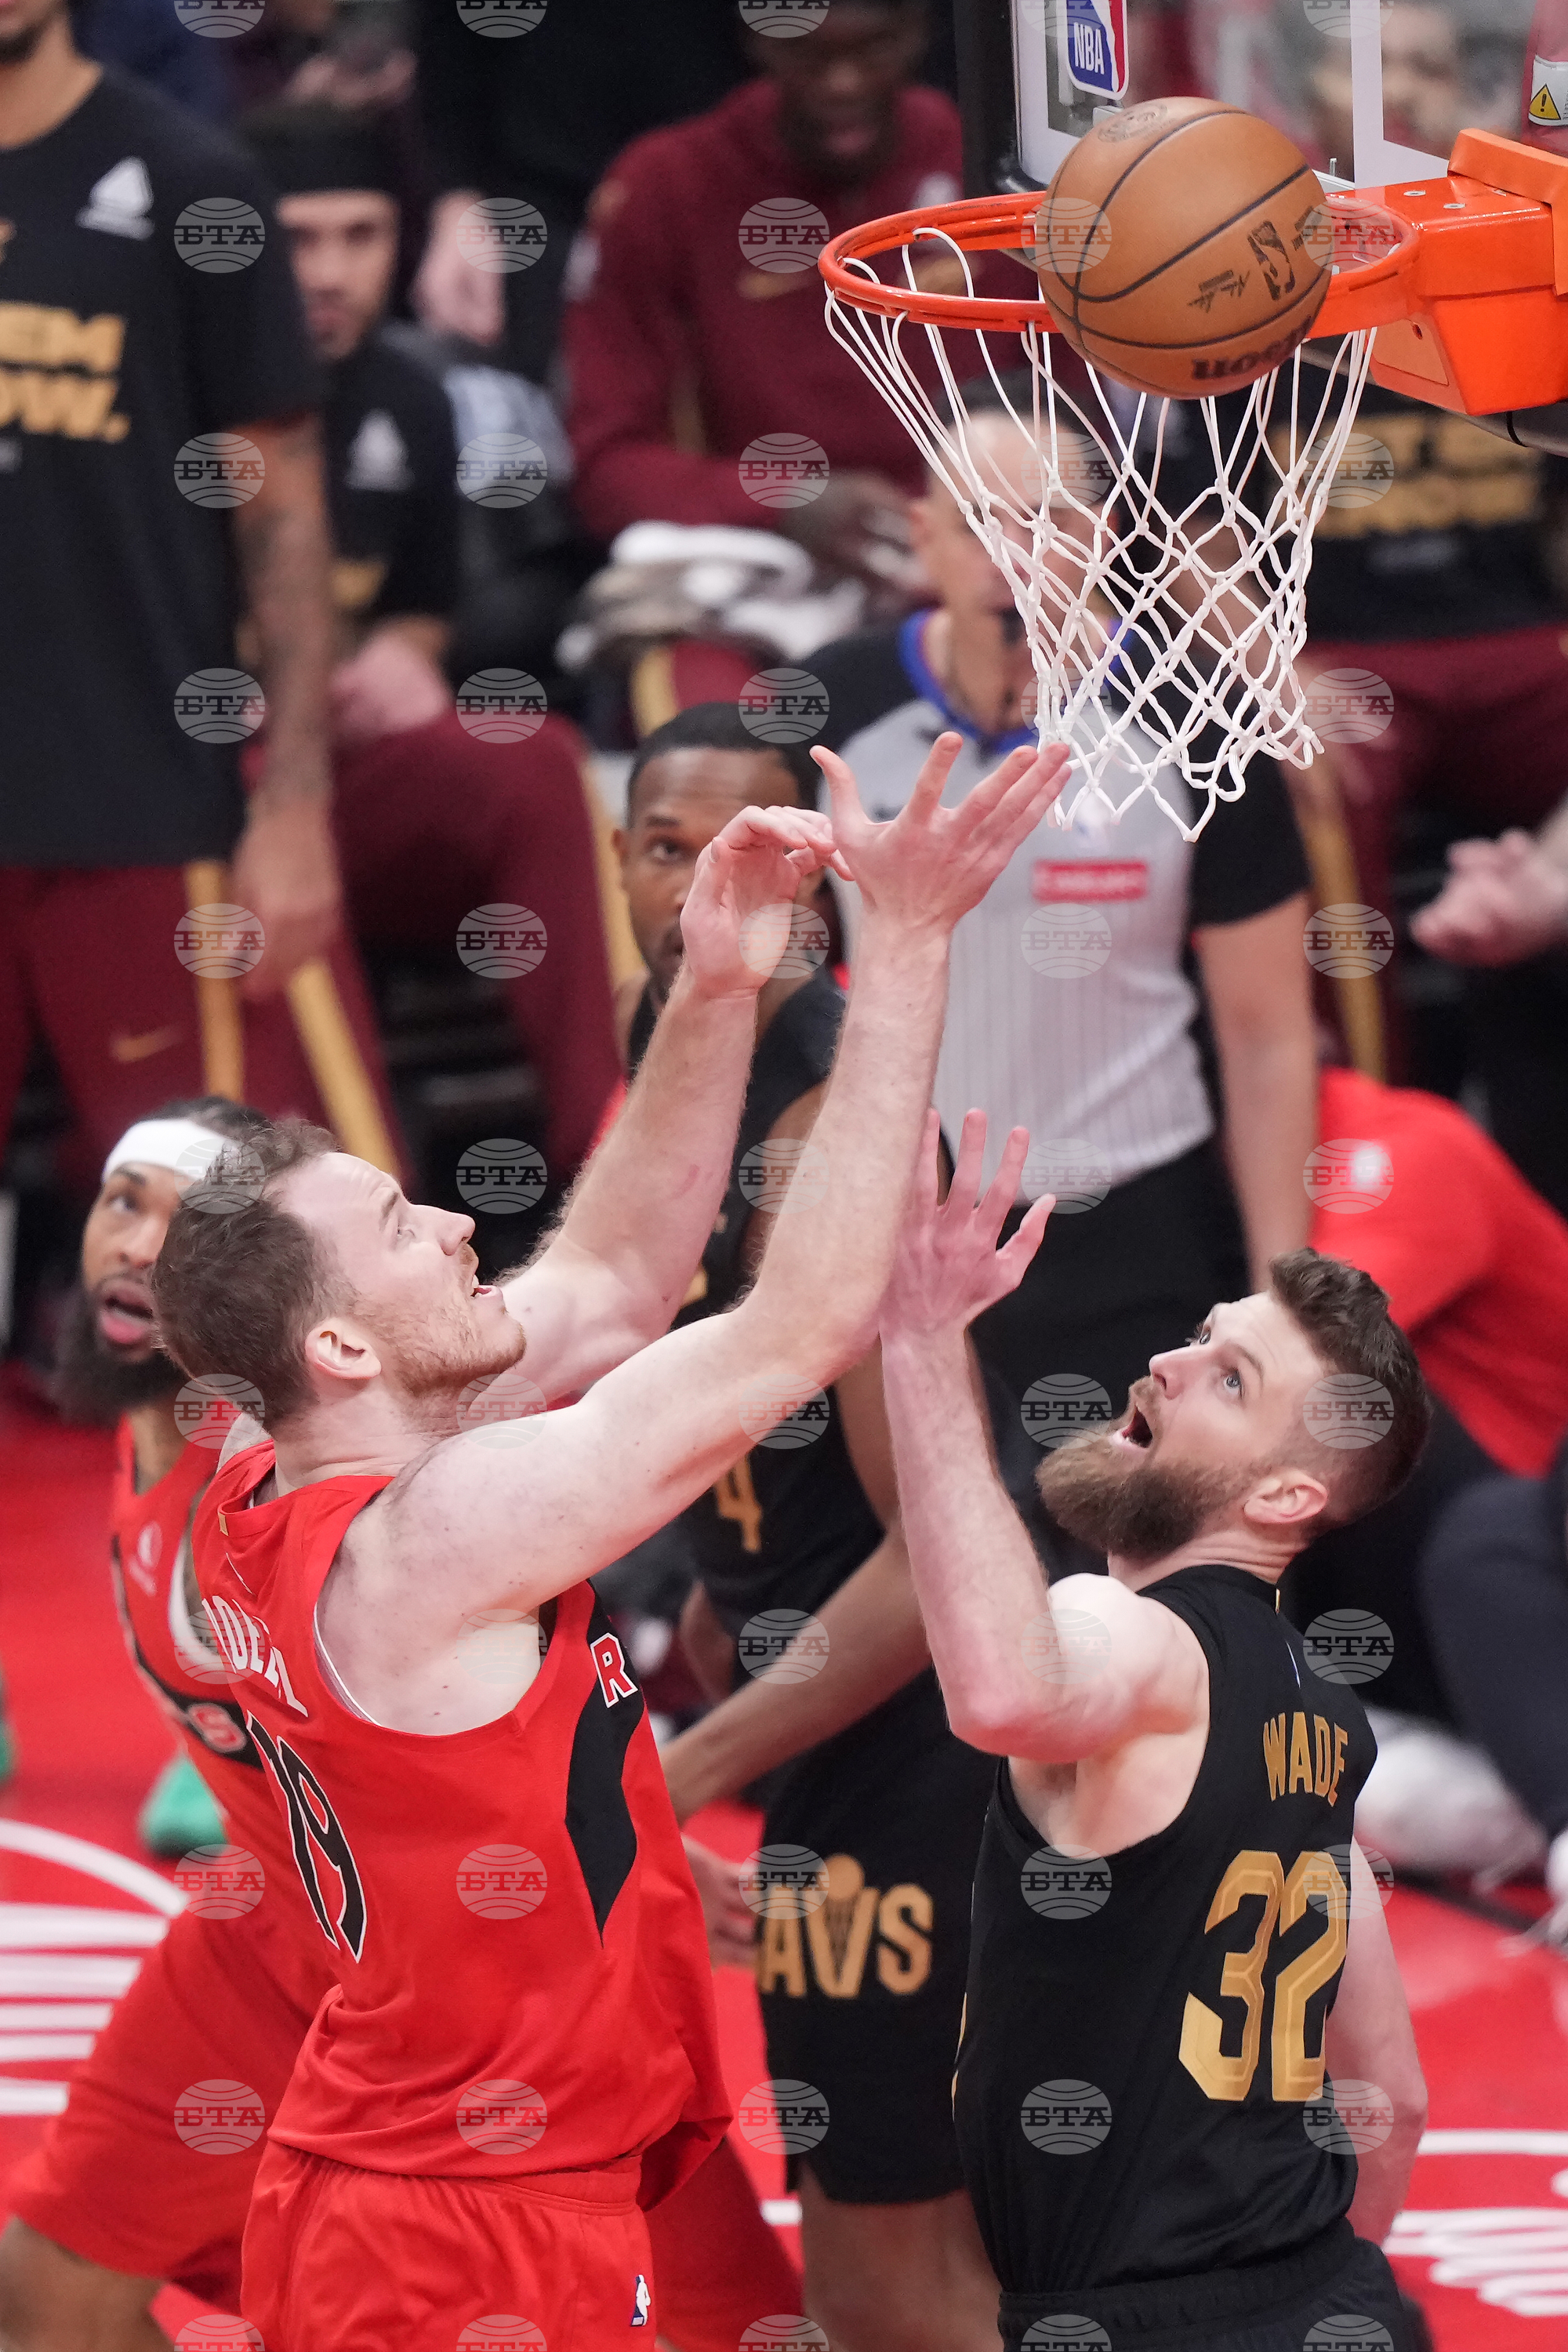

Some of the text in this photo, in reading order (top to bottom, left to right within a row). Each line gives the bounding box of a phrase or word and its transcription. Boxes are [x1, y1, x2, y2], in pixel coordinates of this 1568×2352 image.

[1073, 22, 1105, 74] NBA
[590, 1632, 639, 1708] R
[1263, 1711, 1348, 1807] WADE
[246, 1709, 367, 1963] 19
[1178, 1849, 1348, 2102] 32
